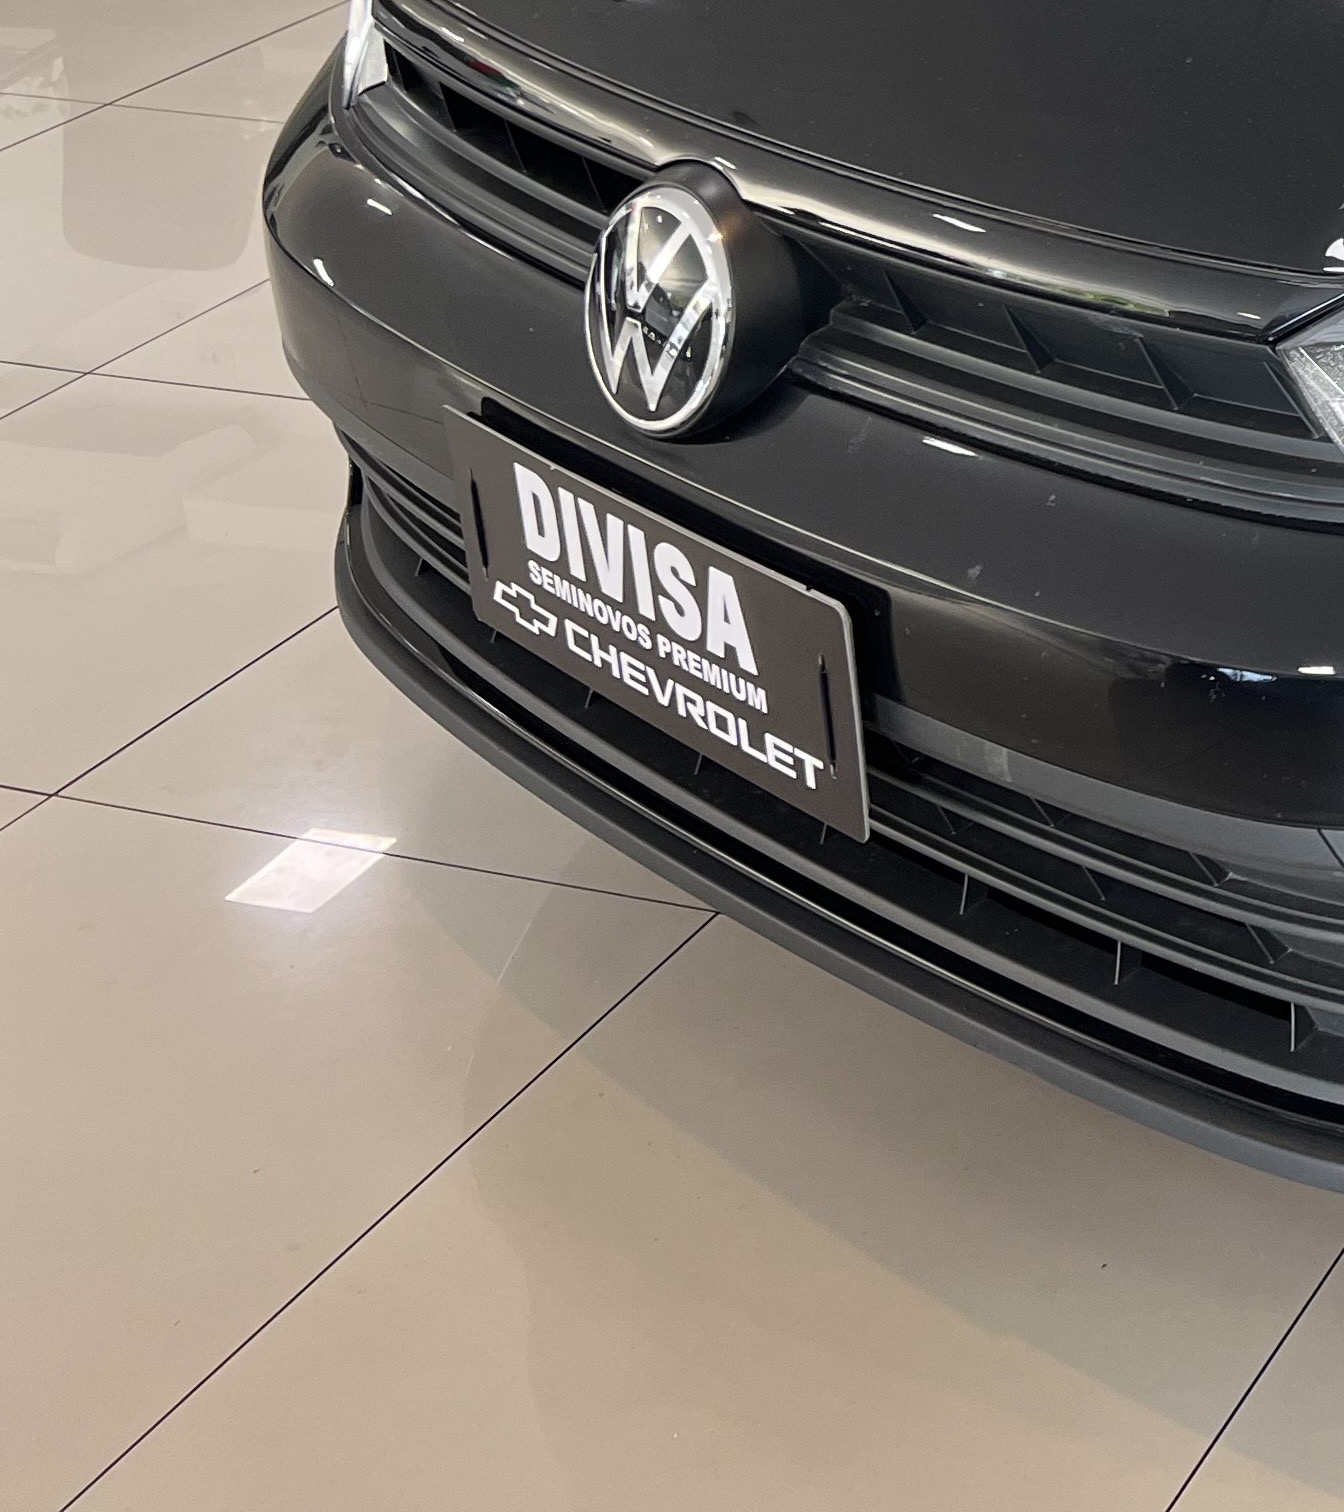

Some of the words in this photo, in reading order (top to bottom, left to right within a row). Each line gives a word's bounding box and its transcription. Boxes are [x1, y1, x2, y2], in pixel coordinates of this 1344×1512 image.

[513, 461, 759, 676] DIVISA
[527, 559, 653, 651] SEMINOVOS
[656, 632, 769, 715] PREMIUM
[563, 618, 824, 790] CHEVROLET
